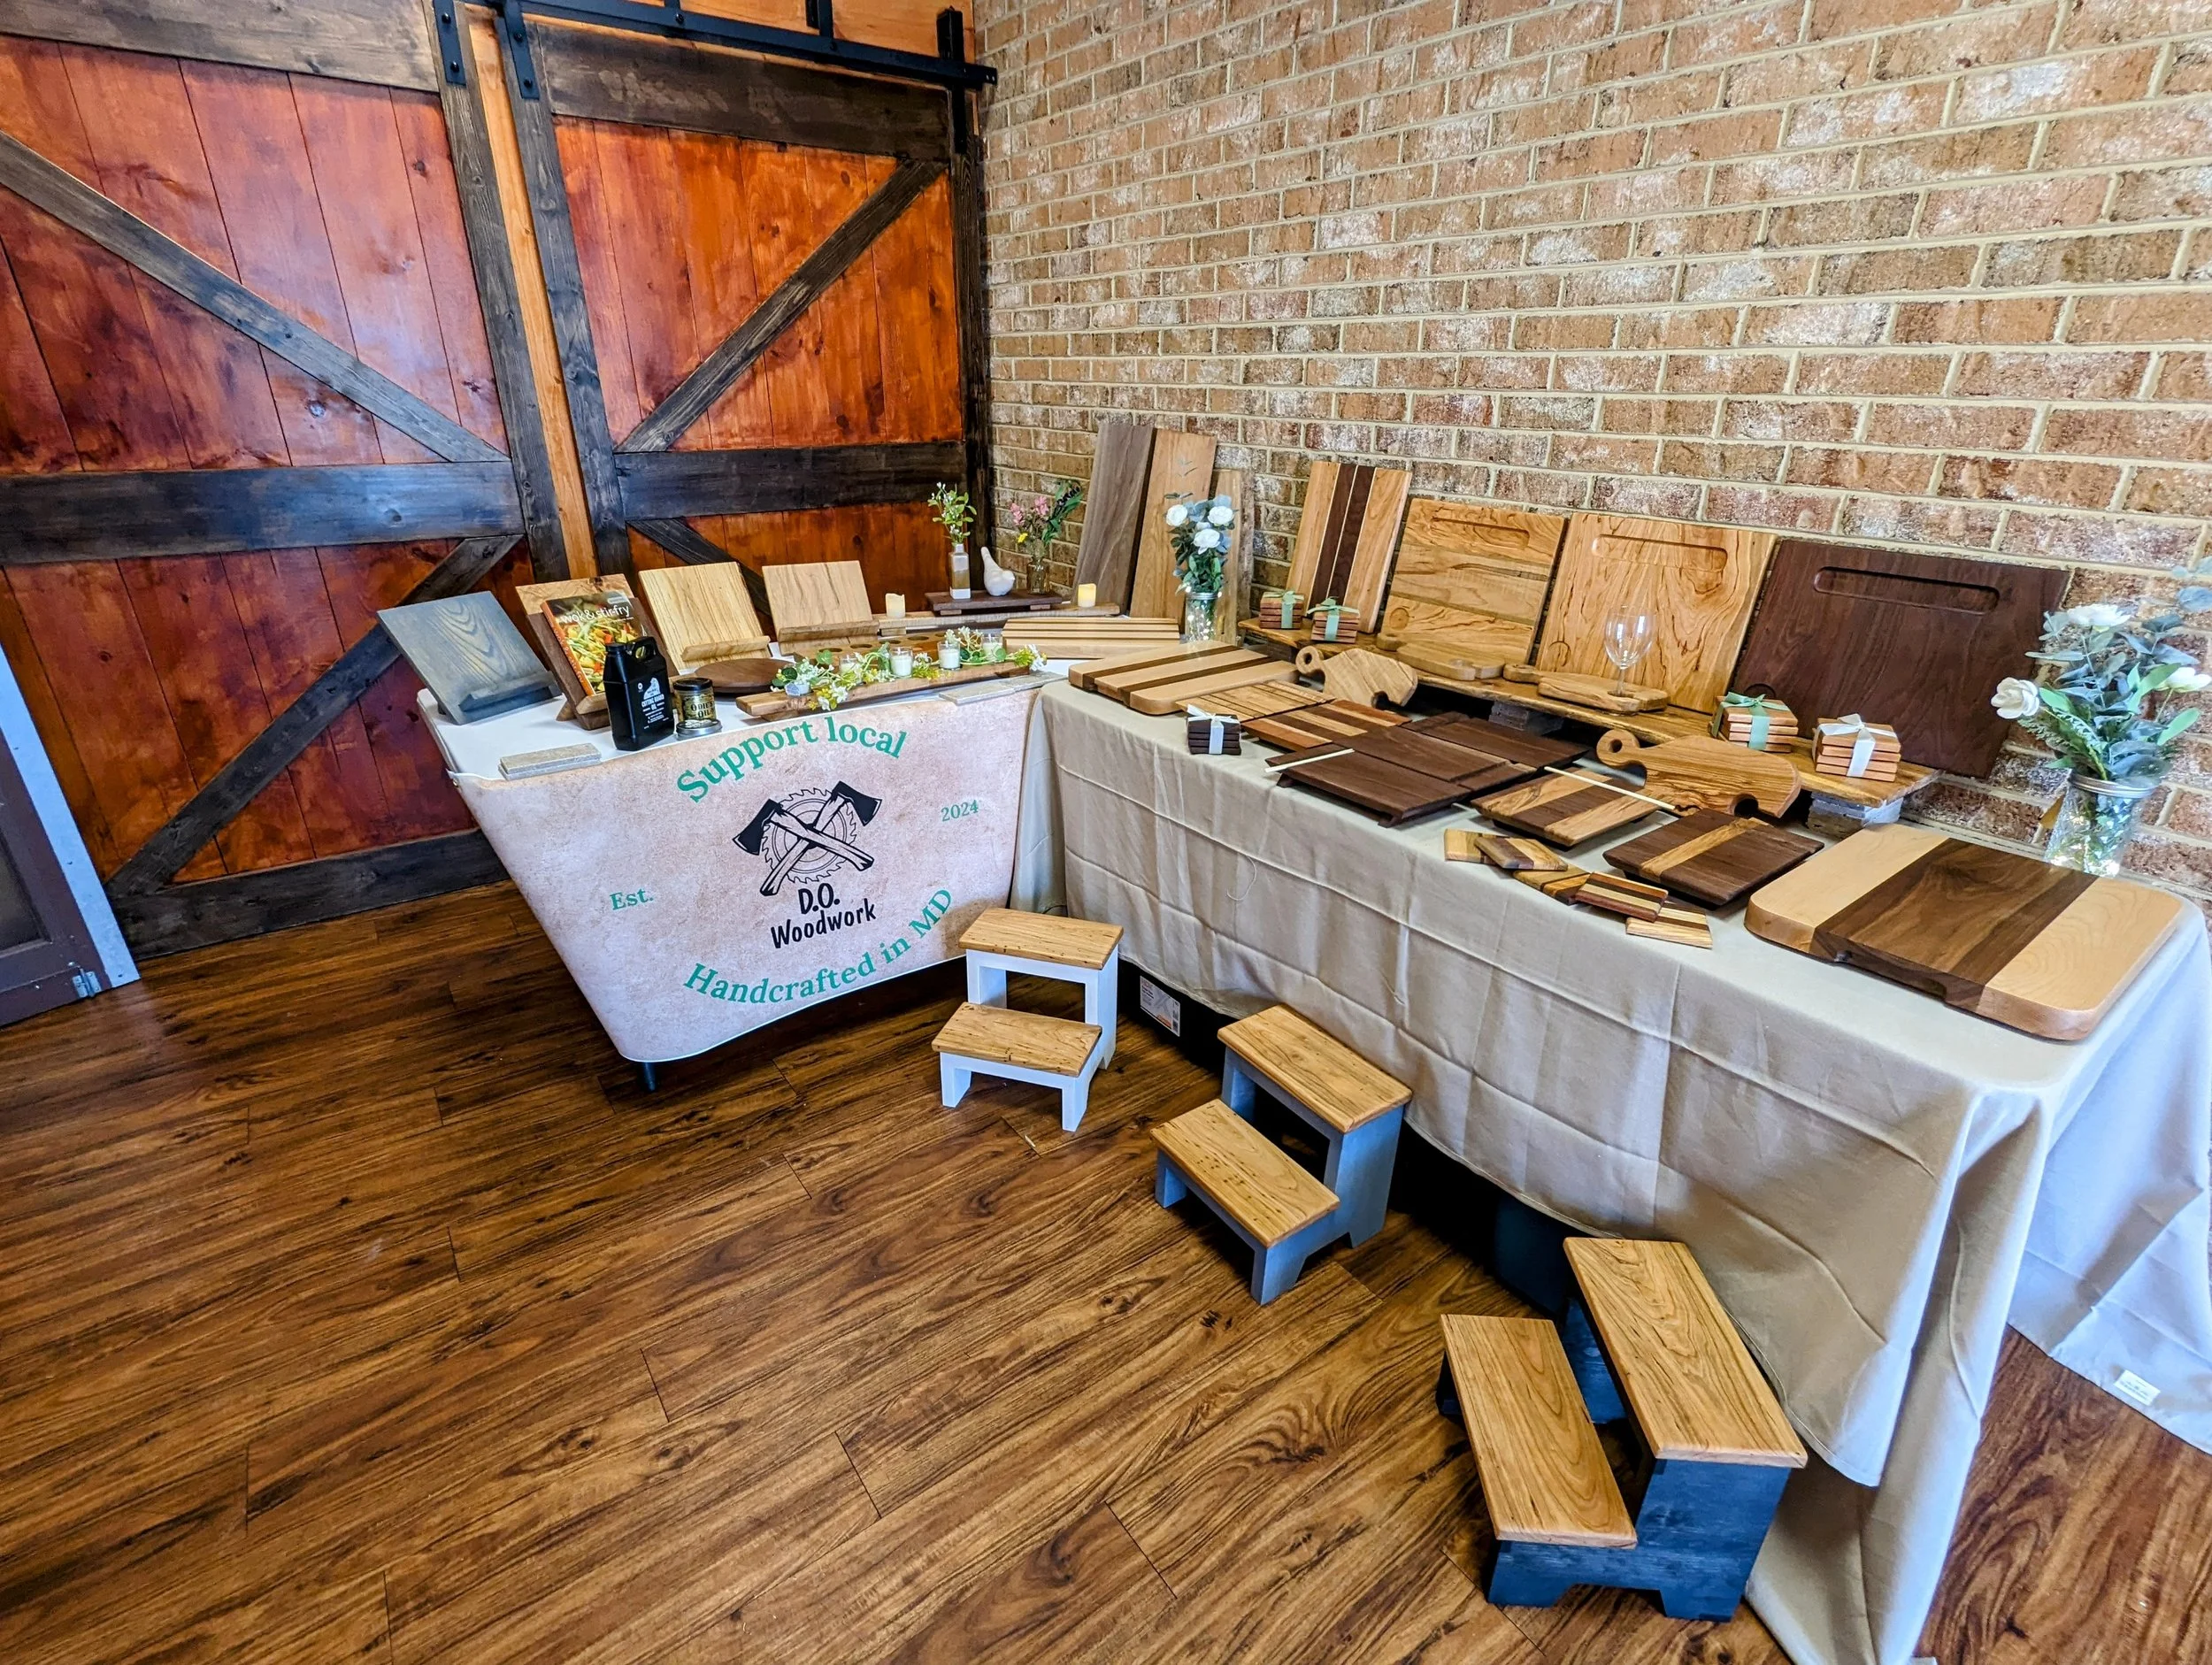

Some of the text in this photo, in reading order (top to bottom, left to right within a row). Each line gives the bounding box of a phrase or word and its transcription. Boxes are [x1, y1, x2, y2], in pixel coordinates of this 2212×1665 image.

[560, 610, 584, 624] wok
[584, 609, 596, 620] &
[595, 605, 630, 618] stir-fry
[677, 716, 908, 803] Support local
[941, 799, 979, 822] 2024
[609, 886, 655, 912] Est.
[798, 882, 841, 916] D.O.
[771, 897, 877, 949] Woodwork
[683, 887, 953, 1006] Handcrafted in MD
